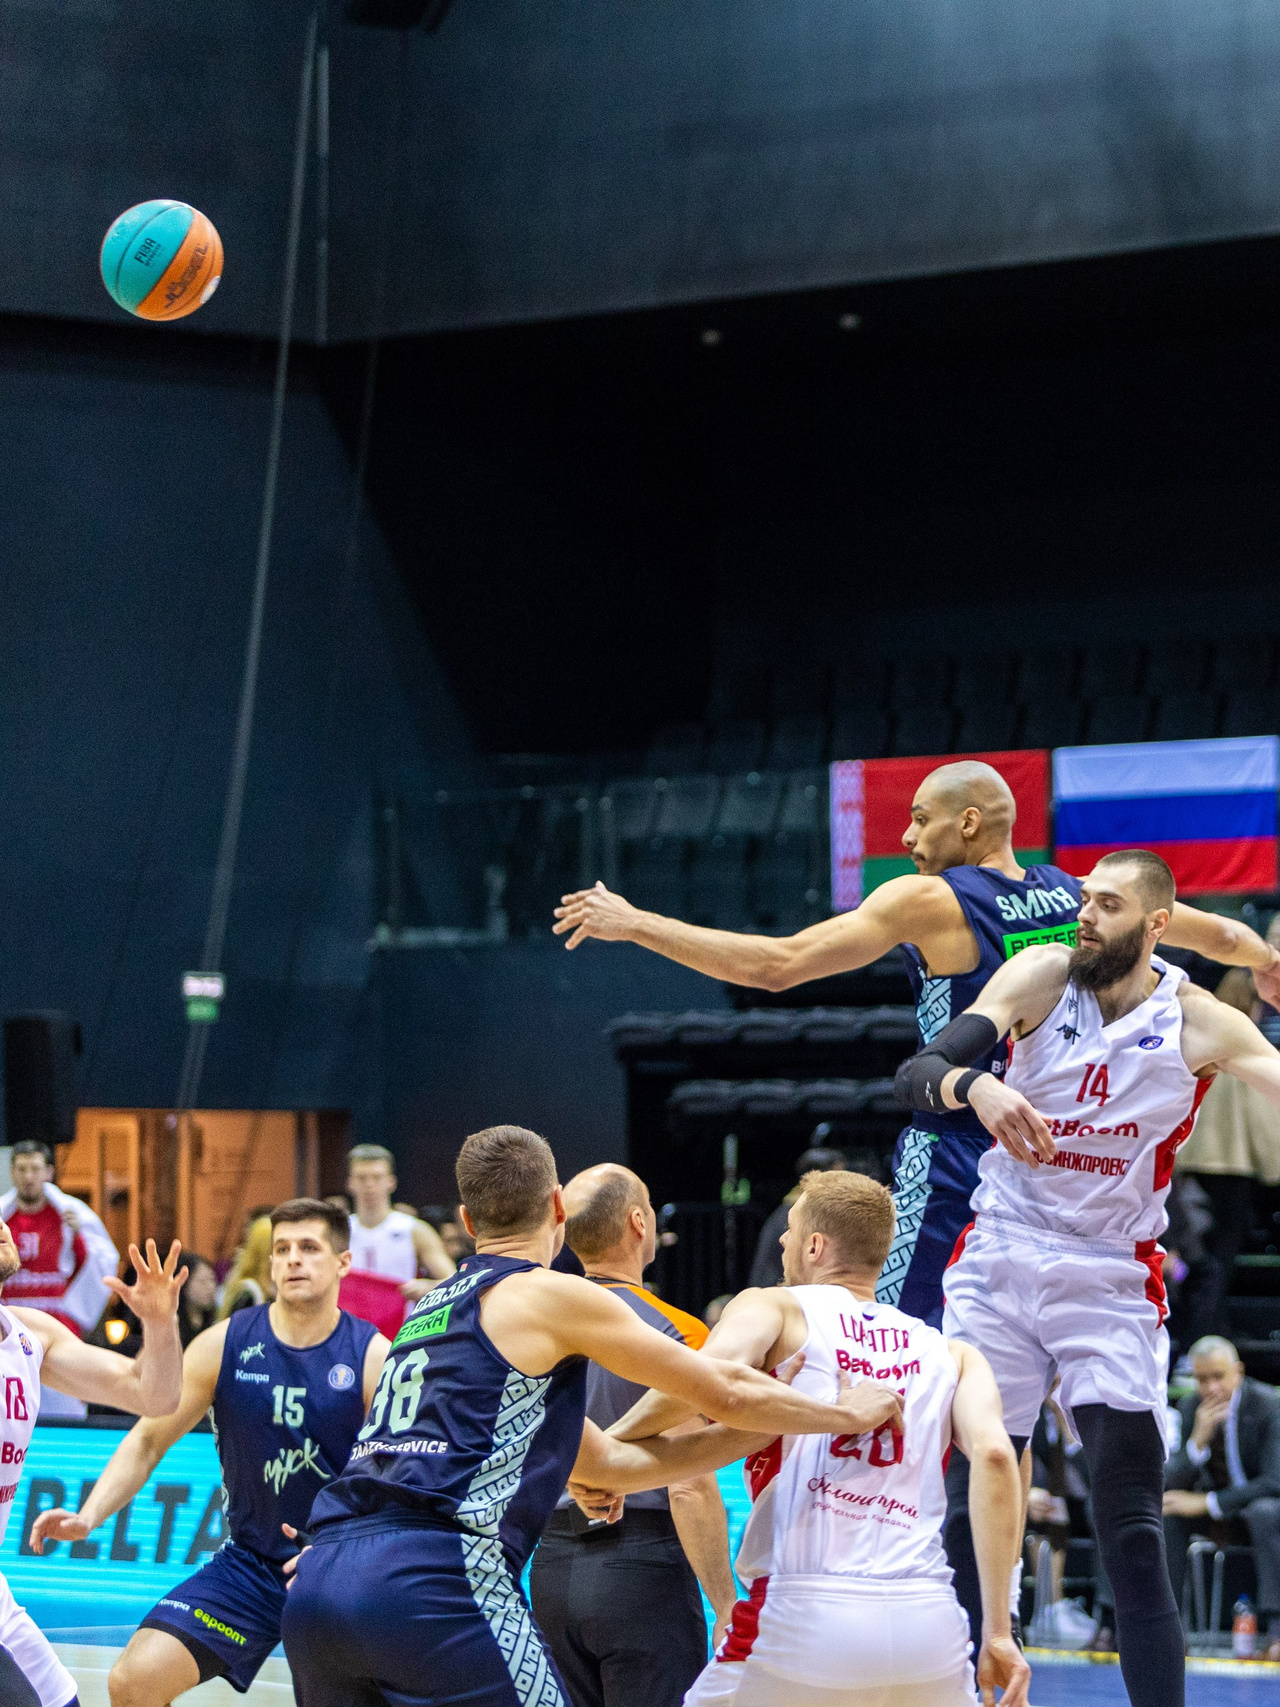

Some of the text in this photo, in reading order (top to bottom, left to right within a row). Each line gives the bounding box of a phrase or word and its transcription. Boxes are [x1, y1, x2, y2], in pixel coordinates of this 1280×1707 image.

[133, 237, 157, 264] FIBA
[995, 885, 1079, 922] SMITH
[1075, 1063, 1111, 1107] 14
[235, 1369, 270, 1385] Kempa
[272, 1384, 307, 1428] 15
